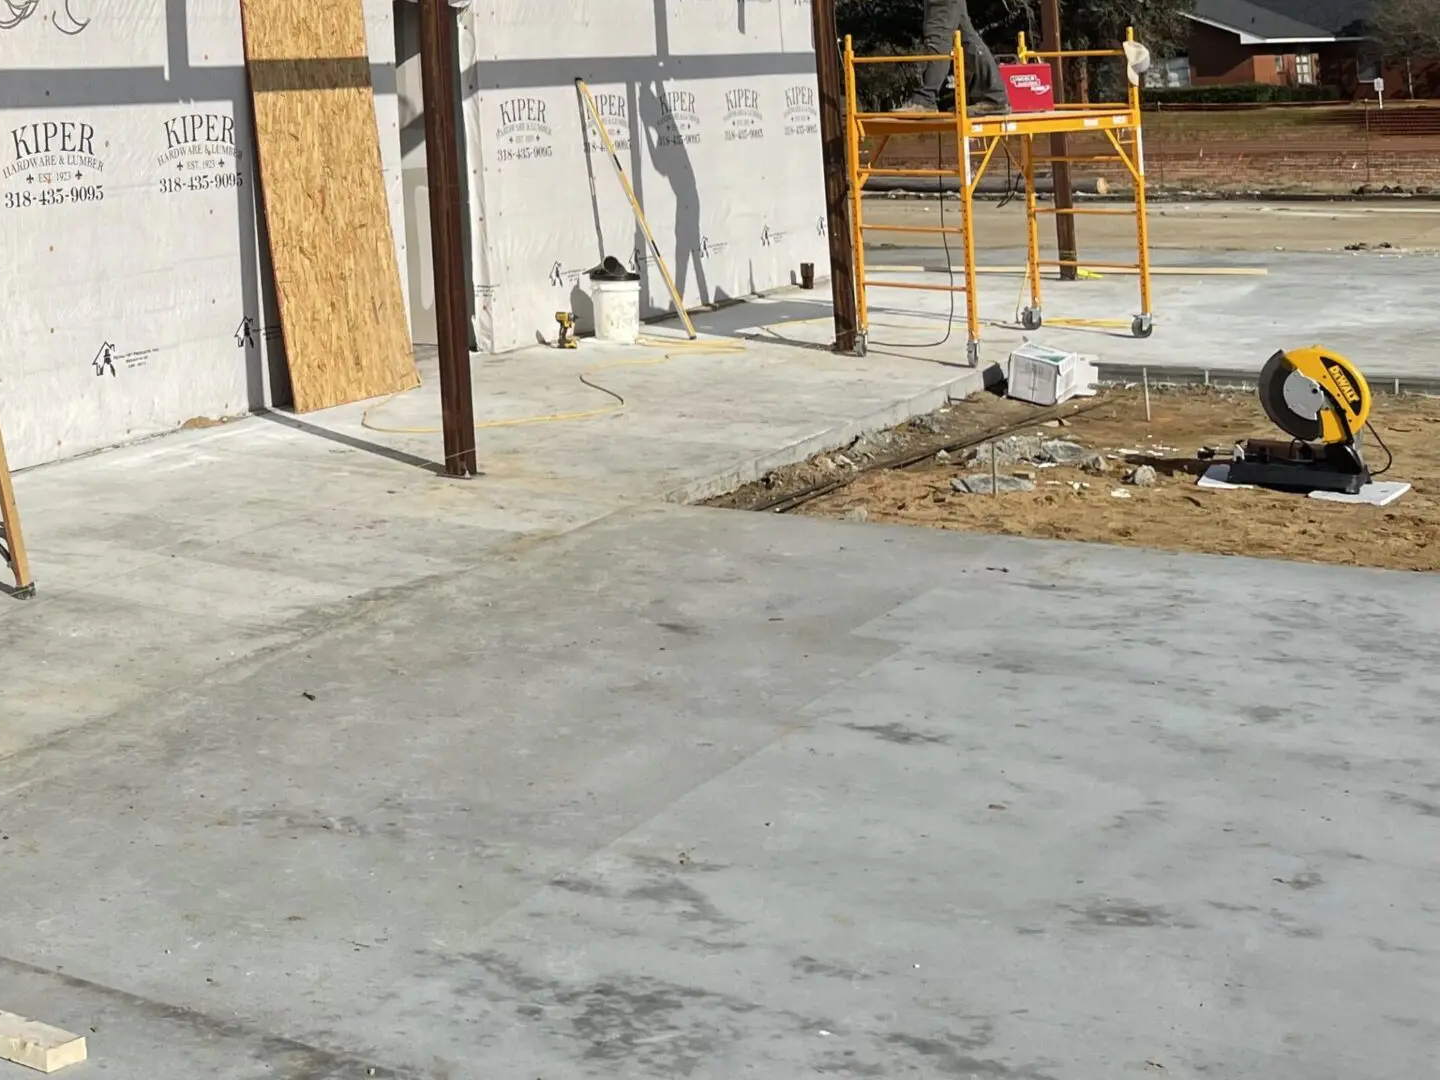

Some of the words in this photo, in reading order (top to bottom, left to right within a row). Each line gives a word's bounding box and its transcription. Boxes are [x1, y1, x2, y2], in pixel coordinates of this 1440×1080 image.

[586, 94, 626, 120] IPER
[660, 91, 696, 116] KIPER
[725, 89, 758, 111] KIPER
[784, 86, 813, 108] KIPER
[500, 98, 546, 126] KIPER
[11, 122, 94, 160] KIPER
[164, 114, 235, 149] KIPER
[2, 154, 57, 179] HARDWARE
[59, 156, 65, 165] &
[67, 154, 104, 172] LUMBER
[157, 144, 203, 166] HARDWARE
[211, 144, 243, 160] LUMBER
[56, 172, 71, 181] 1923
[160, 172, 243, 193] 318-435-9095
[5, 185, 104, 208] 318-435-9095
[1329, 365, 1359, 403] DEWALT
